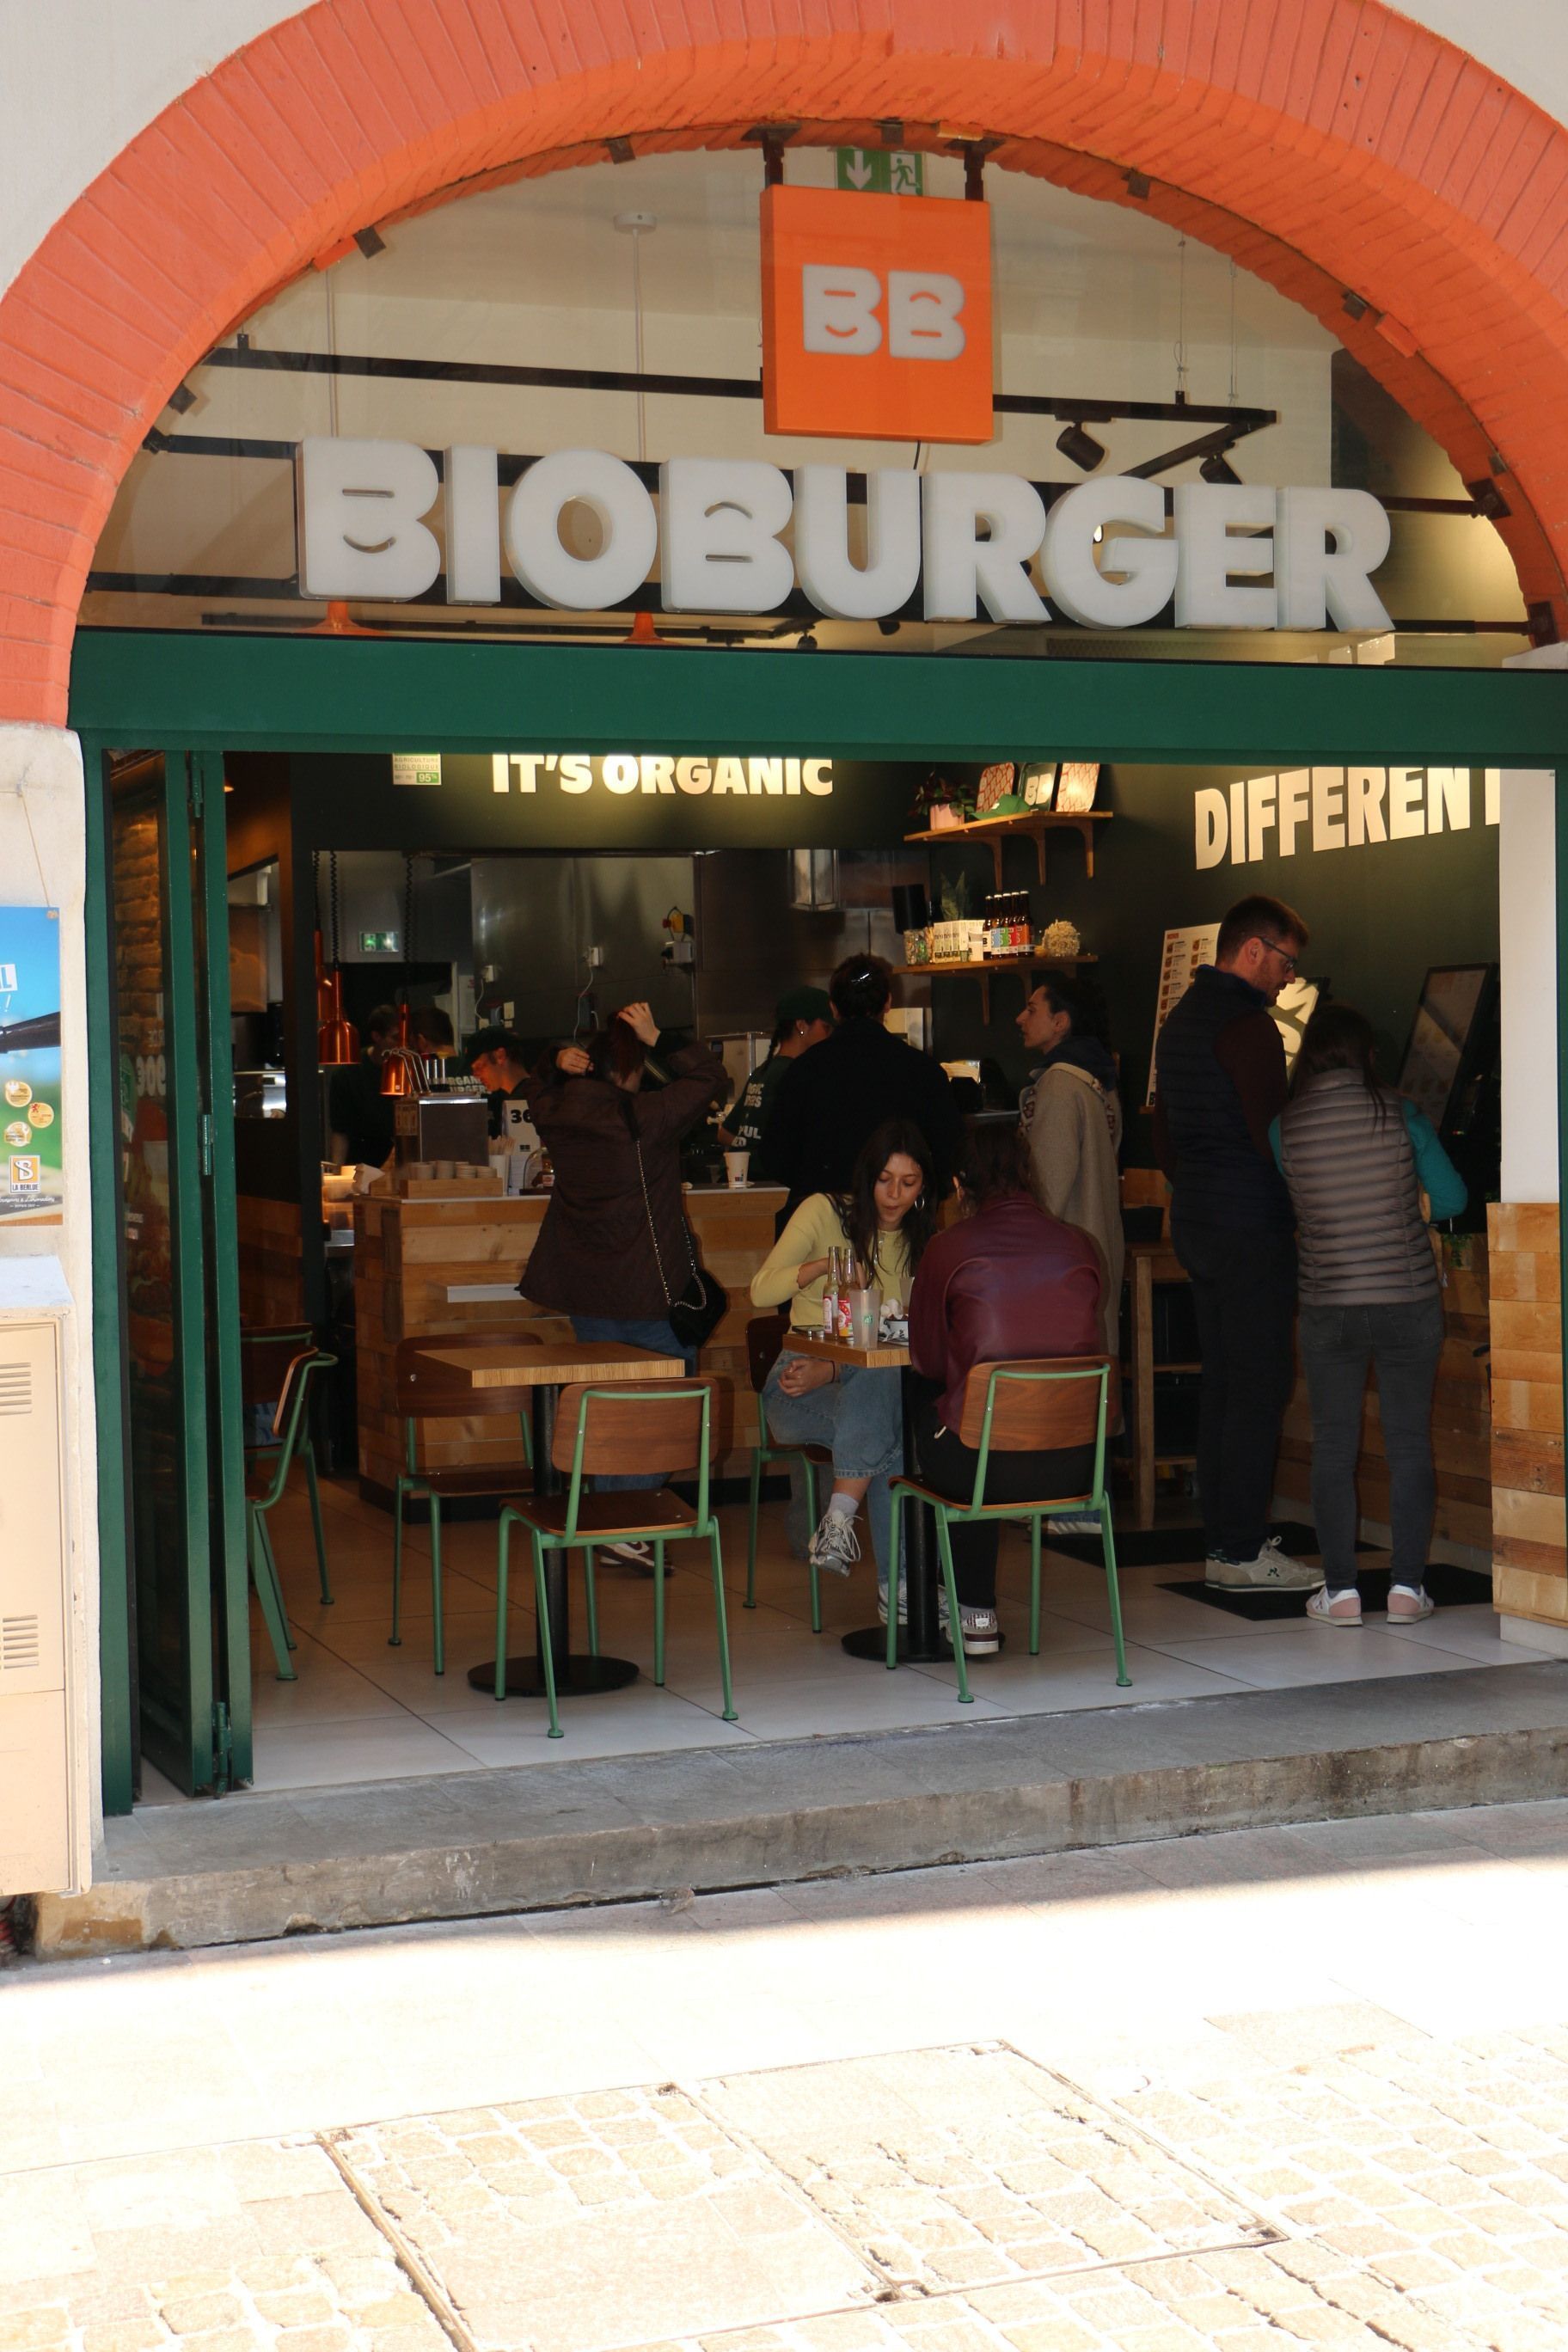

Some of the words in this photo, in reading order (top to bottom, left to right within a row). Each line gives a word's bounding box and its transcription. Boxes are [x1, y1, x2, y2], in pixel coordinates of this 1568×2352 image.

[802, 263, 966, 361] BB
[296, 437, 1396, 634] BIOBURGER
[493, 754, 592, 794] IT'S
[603, 755, 833, 796] ORGANIC
